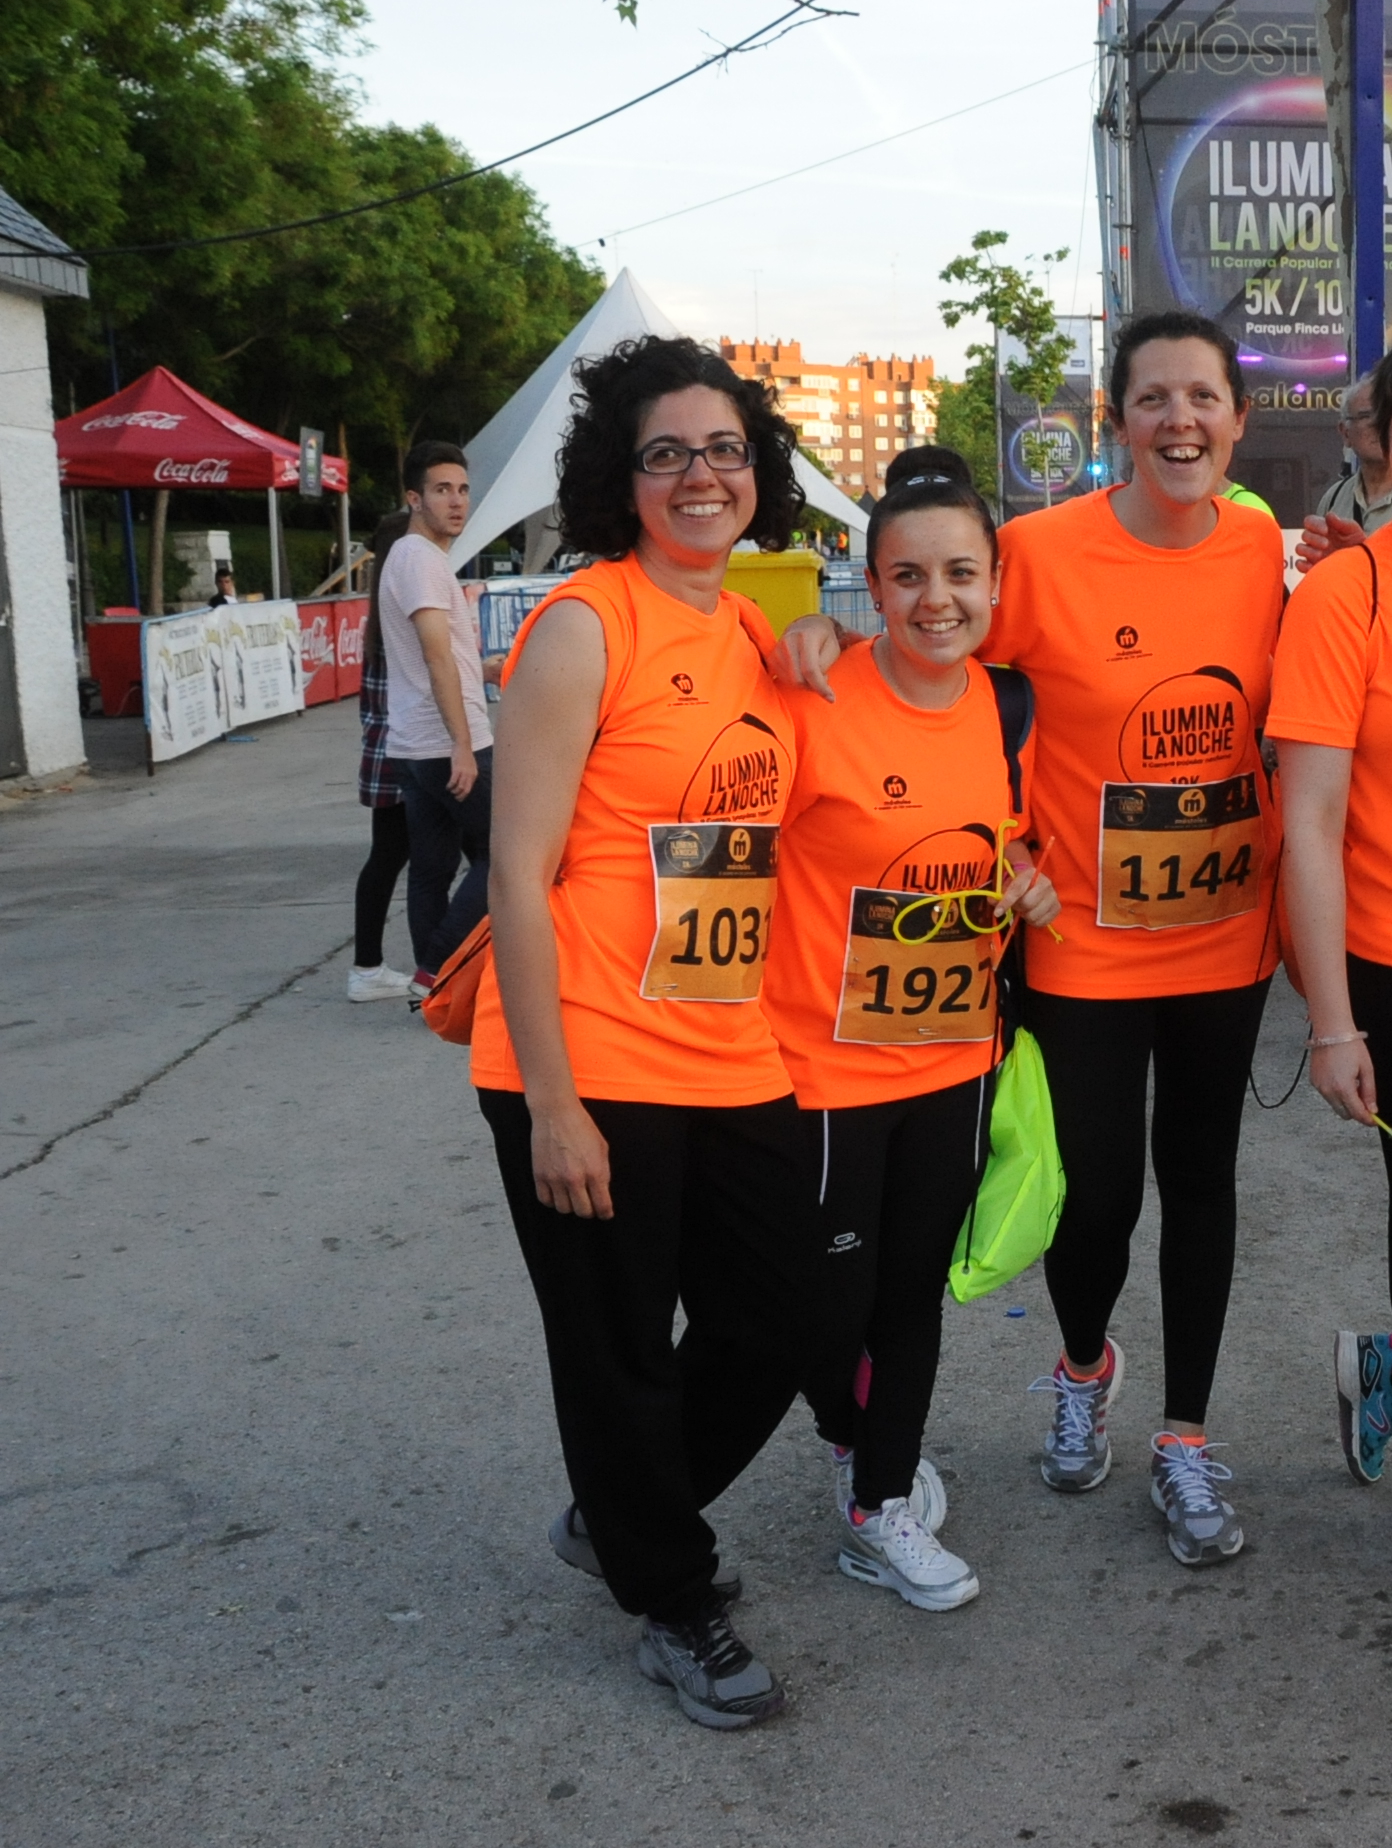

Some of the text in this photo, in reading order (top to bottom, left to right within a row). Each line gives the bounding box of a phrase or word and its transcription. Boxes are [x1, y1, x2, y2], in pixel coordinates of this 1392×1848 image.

[1223, 256, 1276, 268] Carrera
[1280, 257, 1333, 270] Popular
[1244, 278, 1283, 316] 5K
[1314, 279, 1343, 316] 10
[1246, 322, 1292, 335] Parque
[1295, 322, 1329, 334] Finca
[1142, 701, 1234, 737] ILUMINA
[710, 748, 779, 794] ILUMINA
[902, 859, 985, 891] ILUMIN
[1119, 844, 1251, 901] 1144
